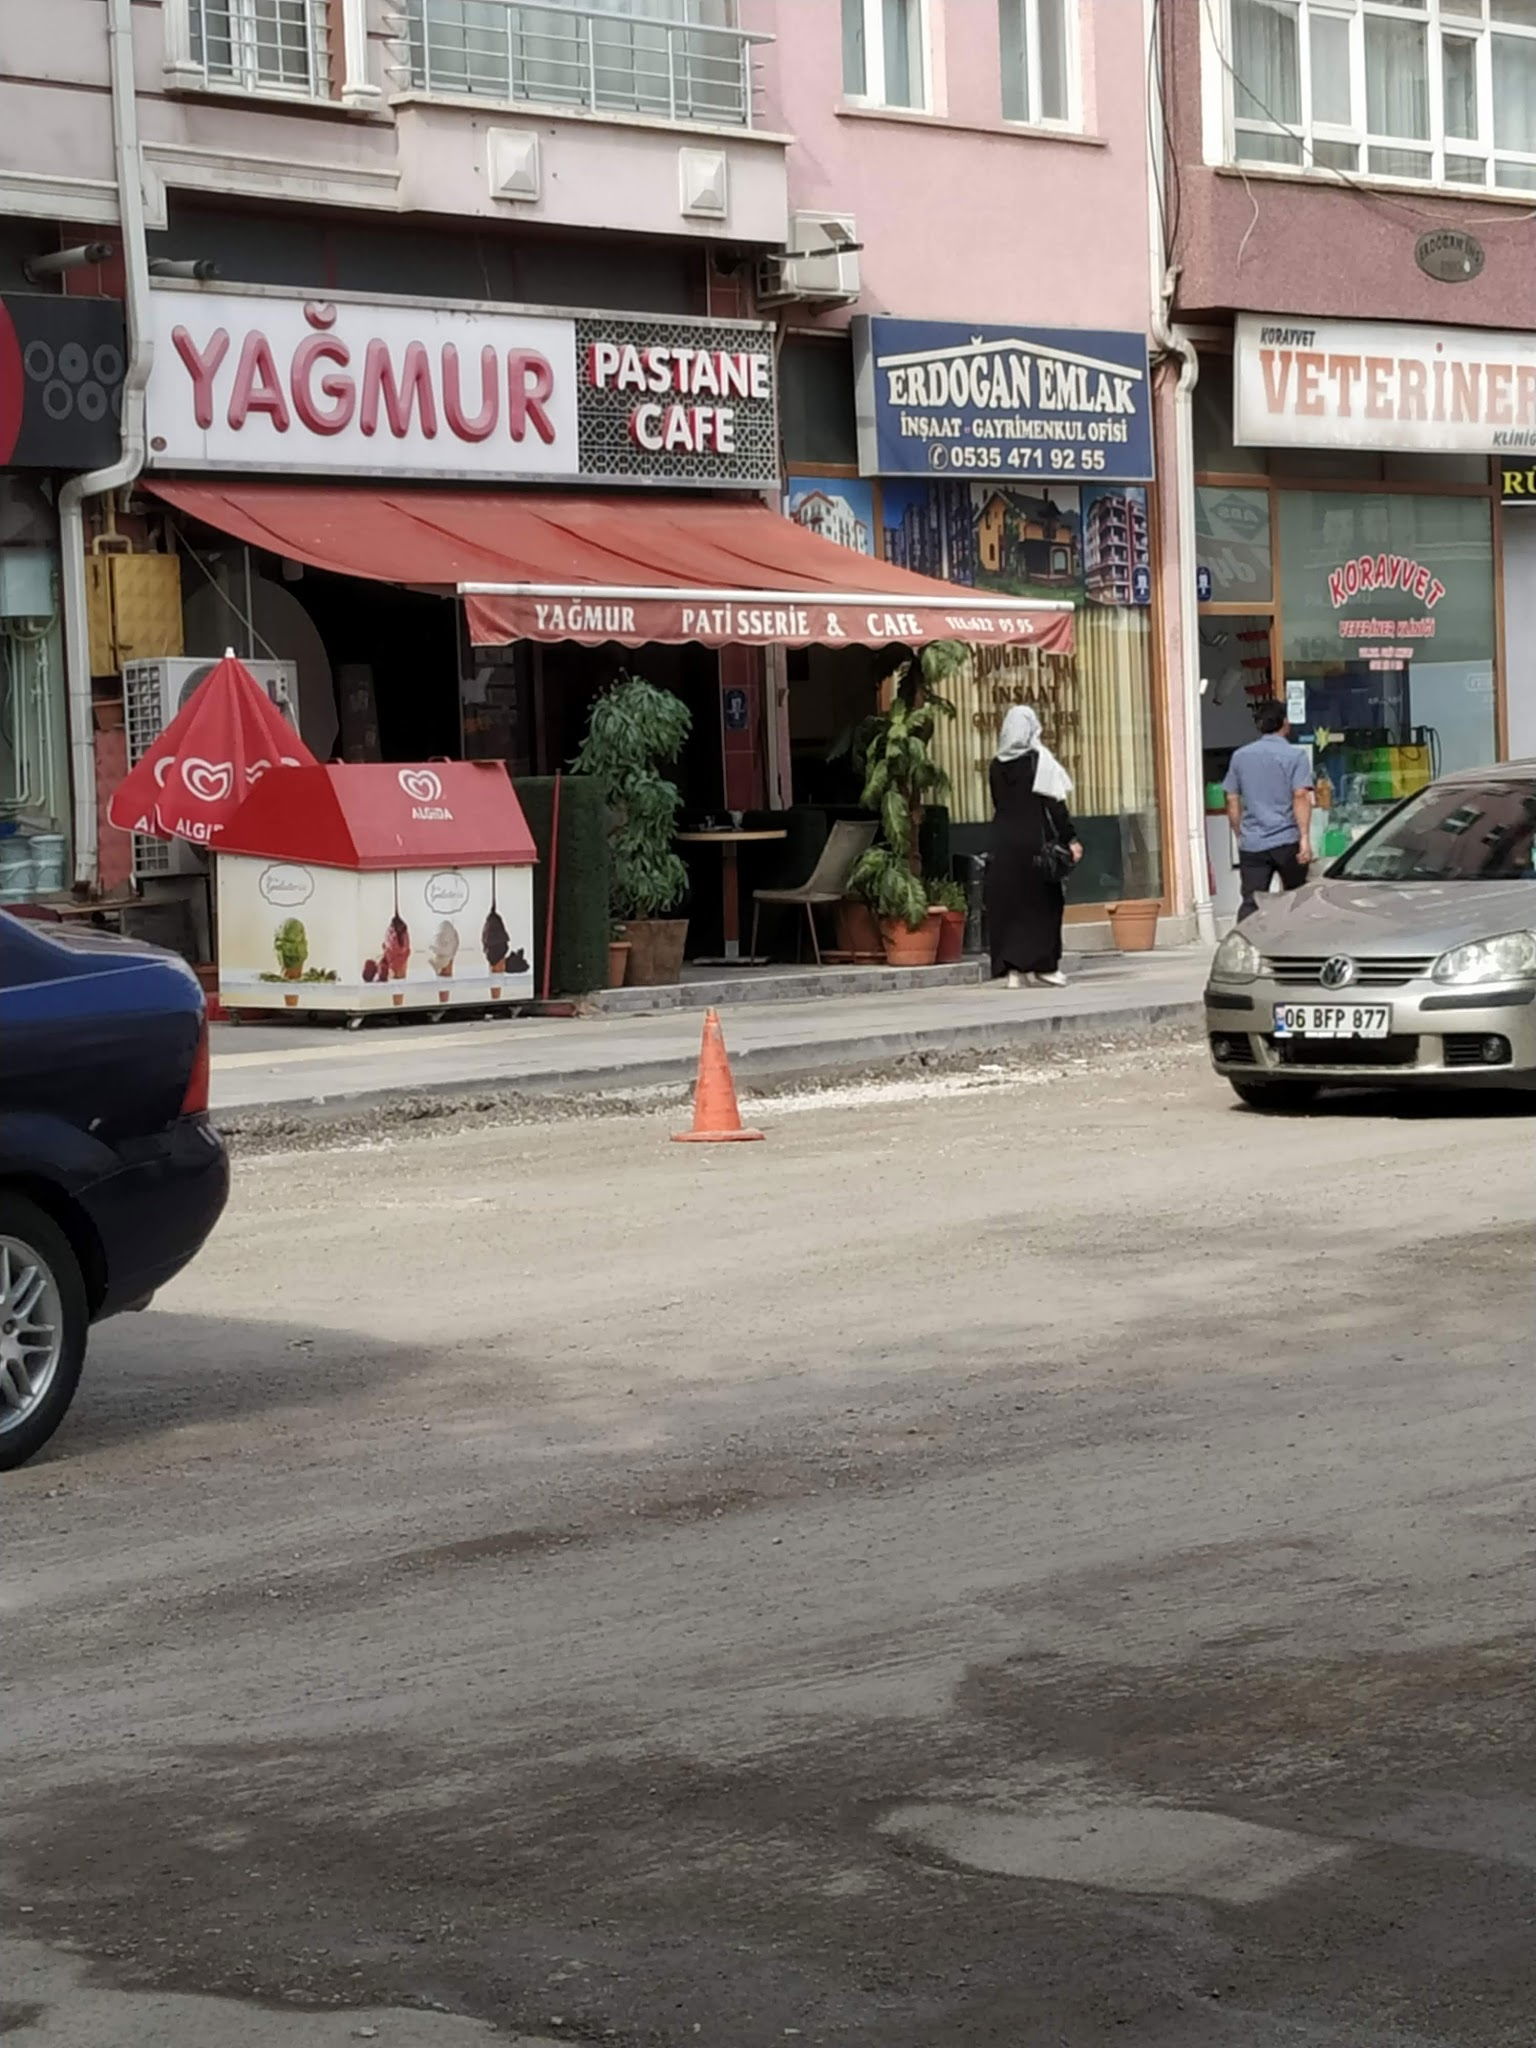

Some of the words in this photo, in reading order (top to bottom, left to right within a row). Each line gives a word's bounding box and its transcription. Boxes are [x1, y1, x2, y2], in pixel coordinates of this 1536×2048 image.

[1259, 327, 1316, 348] KORAYVET
[171, 301, 556, 445] YAĞMUR
[590, 342, 770, 399] PASTANE
[887, 335, 1031, 409] ERDOĞAN
[1037, 357, 1136, 414] EMLAK
[1258, 342, 1536, 425] VETERİNER
[631, 403, 736, 454] CAFE
[900, 411, 962, 442] İNŞAAT
[972, 414, 1086, 441] GAYRİMENKUL
[1088, 418, 1128, 442] OFİSİ
[951, 446, 1001, 468] 0535
[1007, 448, 1043, 468] 471
[1051, 449, 1076, 469] 92
[1081, 449, 1105, 470] 55
[1328, 553, 1446, 609] KORAYVET
[534, 598, 636, 632] YAĞMUR
[826, 612, 846, 637] &
[866, 612, 924, 637] CAFE
[1285, 1008, 1306, 1028] 06
[1313, 1008, 1346, 1029] BFP
[1353, 1009, 1387, 1029] 877
